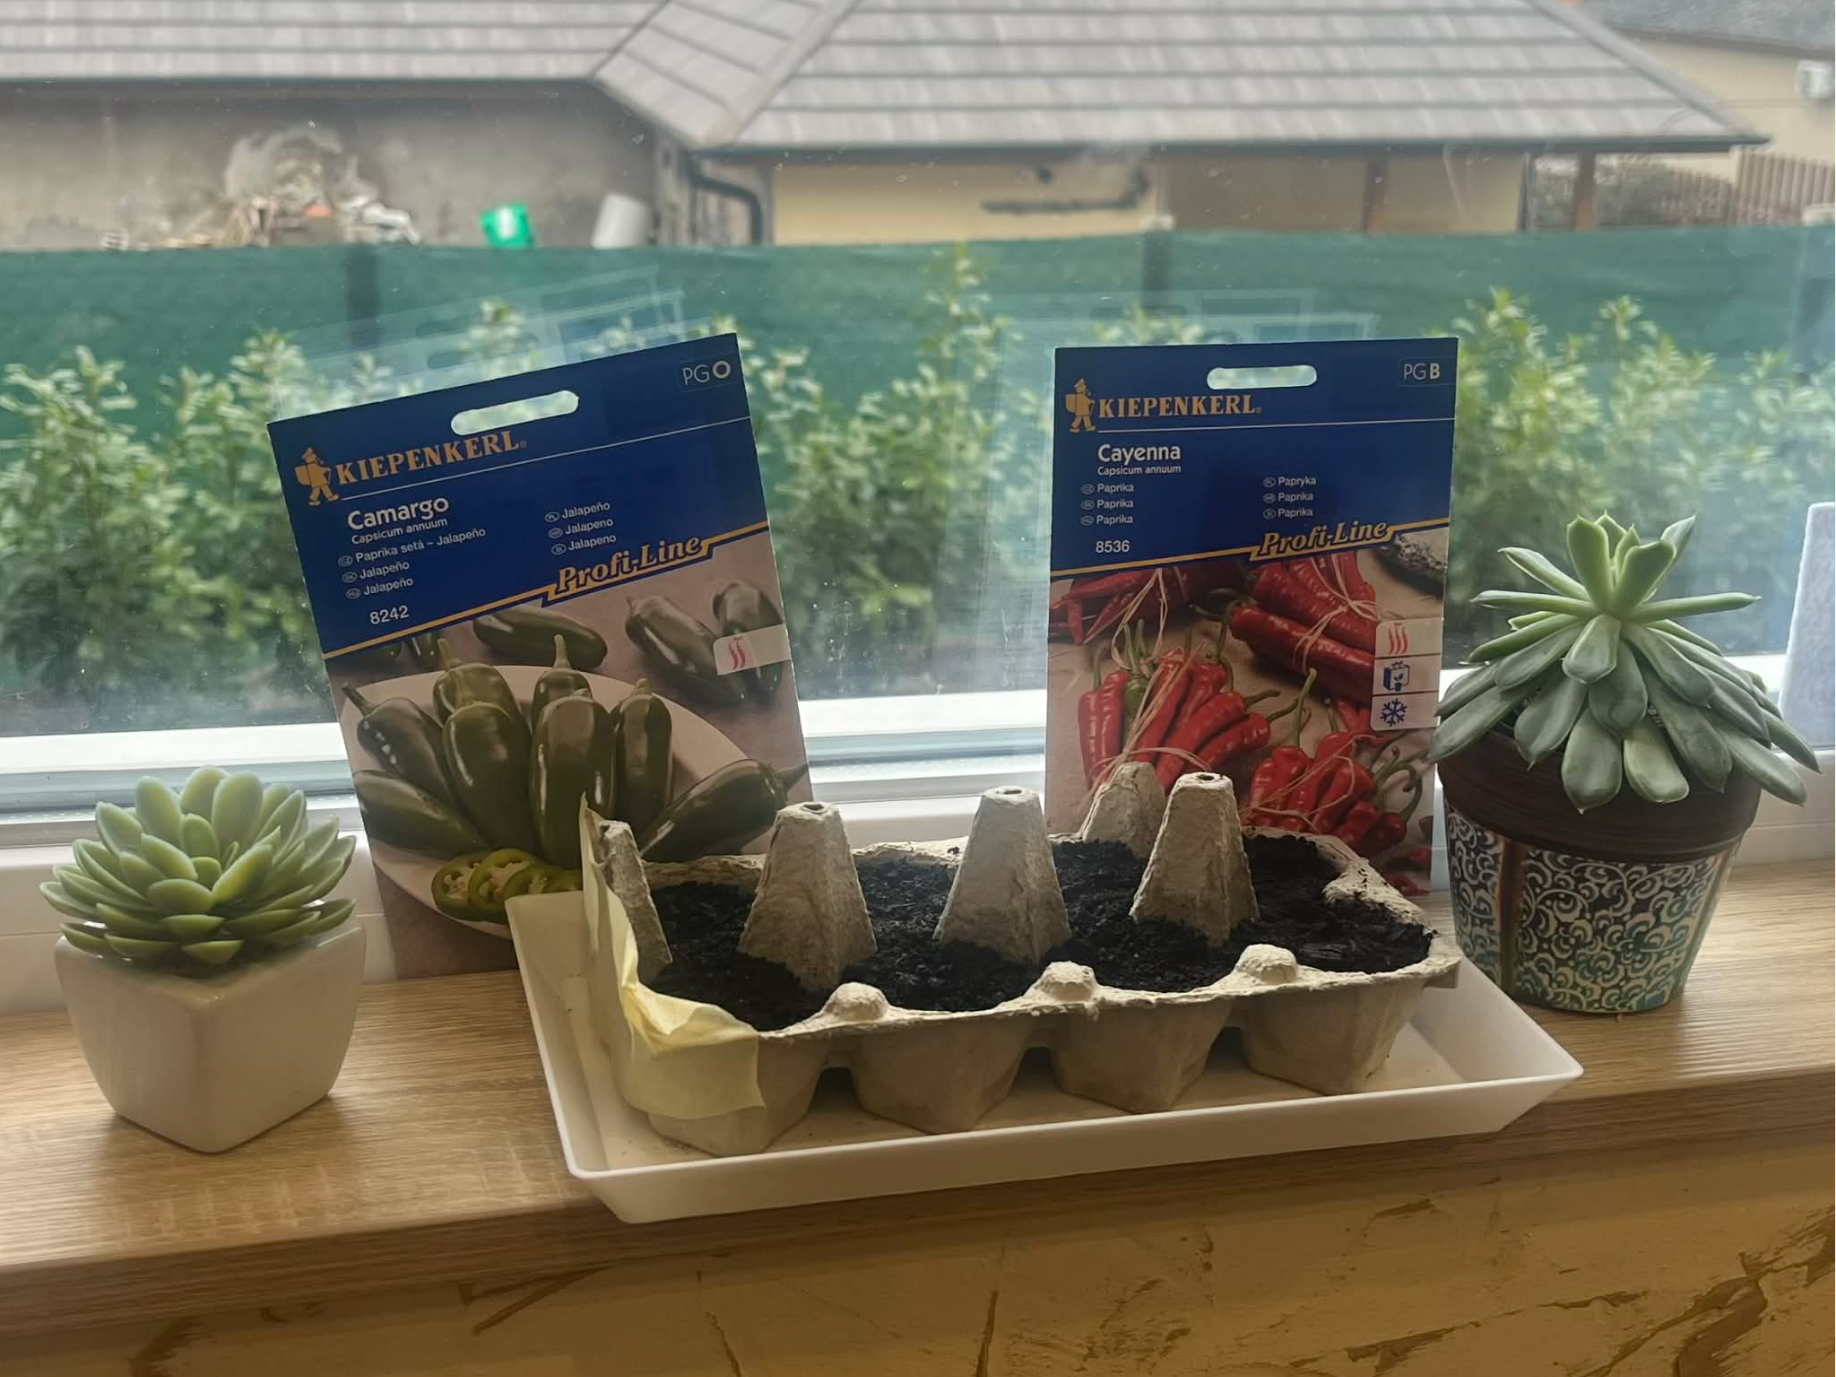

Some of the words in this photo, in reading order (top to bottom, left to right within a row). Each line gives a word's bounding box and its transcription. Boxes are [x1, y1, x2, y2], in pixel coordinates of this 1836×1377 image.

[1097, 444, 1181, 465] Cayenna
[1097, 465, 1142, 477] Capsicum
[1145, 465, 1182, 474] annuum
[1097, 483, 1134, 494] Paprika
[1278, 476, 1317, 487] Papryka
[1097, 499, 1134, 510] Paprika
[1278, 492, 1314, 503] Paprika
[347, 497, 449, 530] Camargo
[562, 501, 611, 519] Jalapeño
[1278, 508, 1314, 519] Paprika
[1096, 515, 1133, 526] Paprika
[351, 527, 403, 544] Capsicum
[406, 518, 448, 533] annuum
[1260, 521, 1387, 555] Profi-Line
[355, 546, 398, 563] Paprika
[436, 528, 486, 546] Jalapeño
[1095, 540, 1131, 553] 8536
[359, 561, 410, 580] Jalapeño
[558, 537, 700, 592] Profi-Line
[363, 577, 414, 596] Jalapeño
[369, 605, 410, 625] 8242
